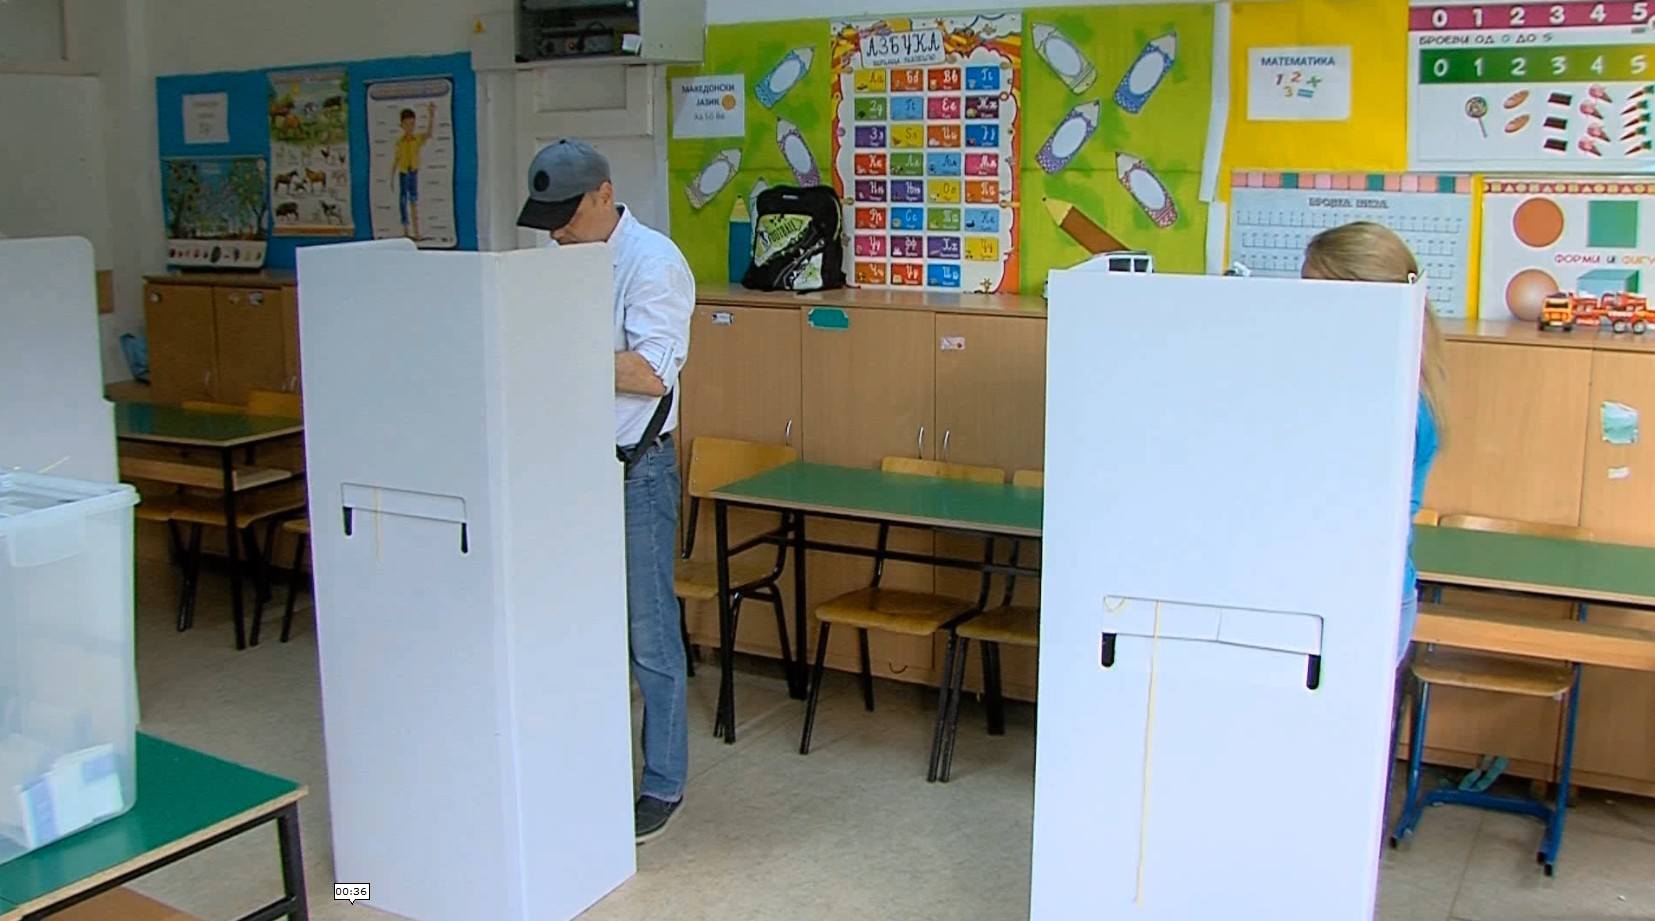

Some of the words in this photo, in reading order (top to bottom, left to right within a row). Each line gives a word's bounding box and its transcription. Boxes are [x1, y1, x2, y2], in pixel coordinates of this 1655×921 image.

[1432, 9, 1448, 27] 0
[1472, 8, 1483, 27] 1
[1510, 7, 1526, 26] 2
[1550, 6, 1565, 24] 3
[1590, 4, 1606, 23] 4
[1632, 2, 1648, 22] 5
[866, 31, 940, 56] АЗБУКА
[1419, 35, 1469, 45] БРОЕВИ
[1261, 56, 1335, 66] МАТЕМАТИКА
[1433, 58, 1449, 77] 0
[1474, 58, 1484, 76] 1
[1511, 57, 1527, 75] 2
[1551, 56, 1567, 74] 3
[1590, 55, 1604, 74] 4
[1631, 55, 1647, 73] 5
[1555, 254, 1600, 263] ФОРМИ
